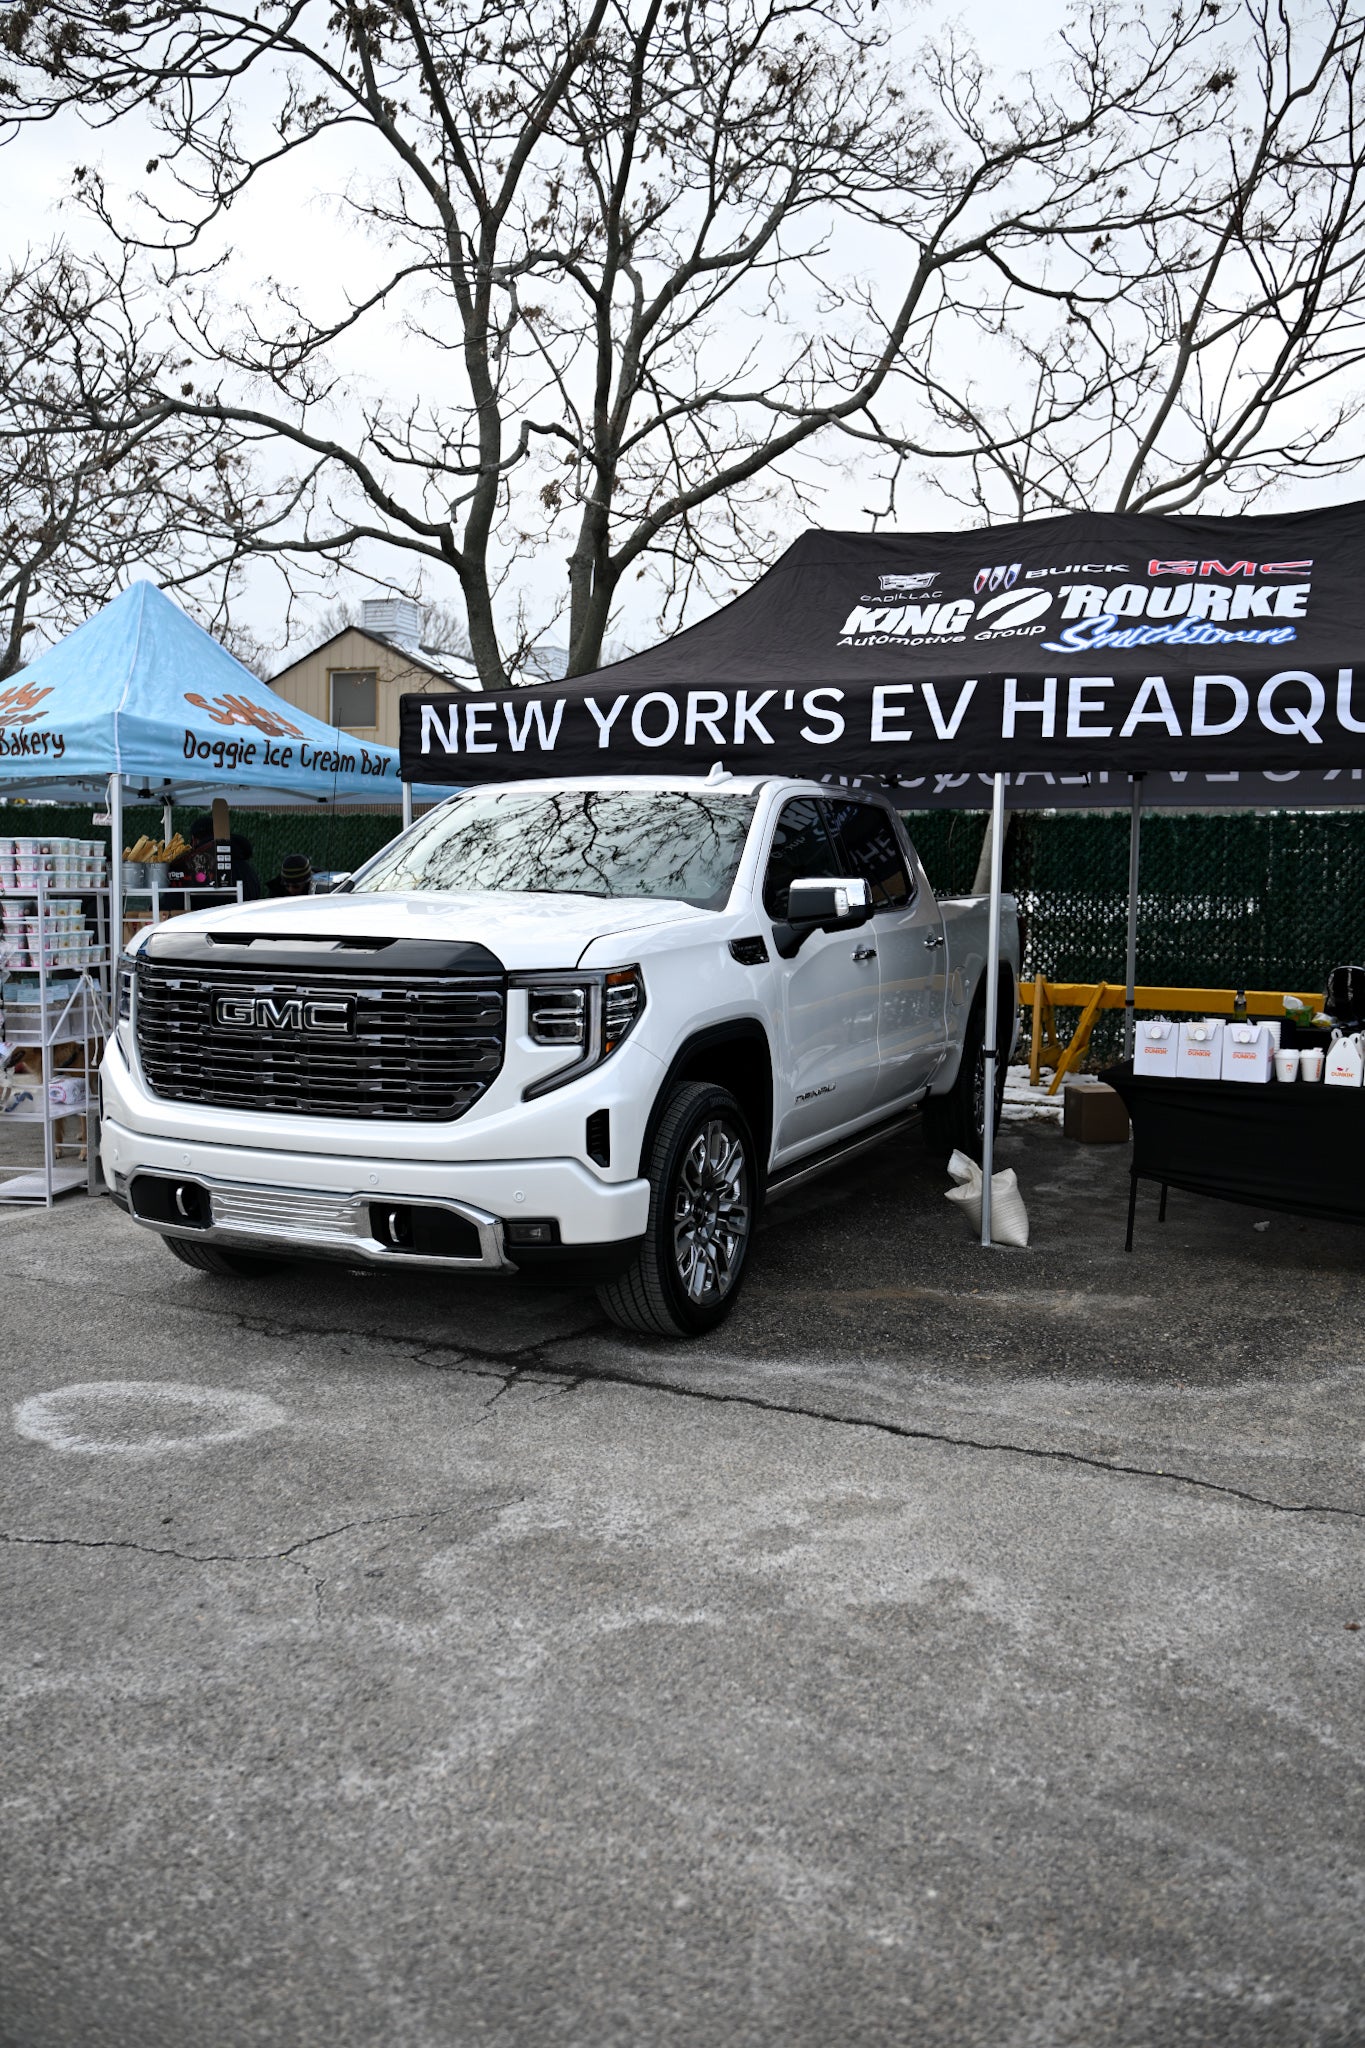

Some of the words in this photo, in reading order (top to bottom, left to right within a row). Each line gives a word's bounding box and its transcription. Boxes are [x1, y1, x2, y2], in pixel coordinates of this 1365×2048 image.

[1025, 564, 1130, 579] BUICK
[1148, 559, 1313, 577] GMC
[860, 590, 943, 603] CADILLAC
[839, 599, 976, 635] KING
[1040, 613, 1297, 653] Smithtown
[836, 634, 967, 647] Automotive
[974, 625, 1046, 642] Group
[420, 699, 566, 755] NEW
[584, 687, 846, 749] YORK'S
[870, 680, 978, 743] EV
[184, 729, 257, 769] Doggie
[263, 740, 292, 768] Ice
[301, 744, 355, 773] Cream
[360, 749, 391, 777] Bar
[216, 997, 348, 1032] GMC
